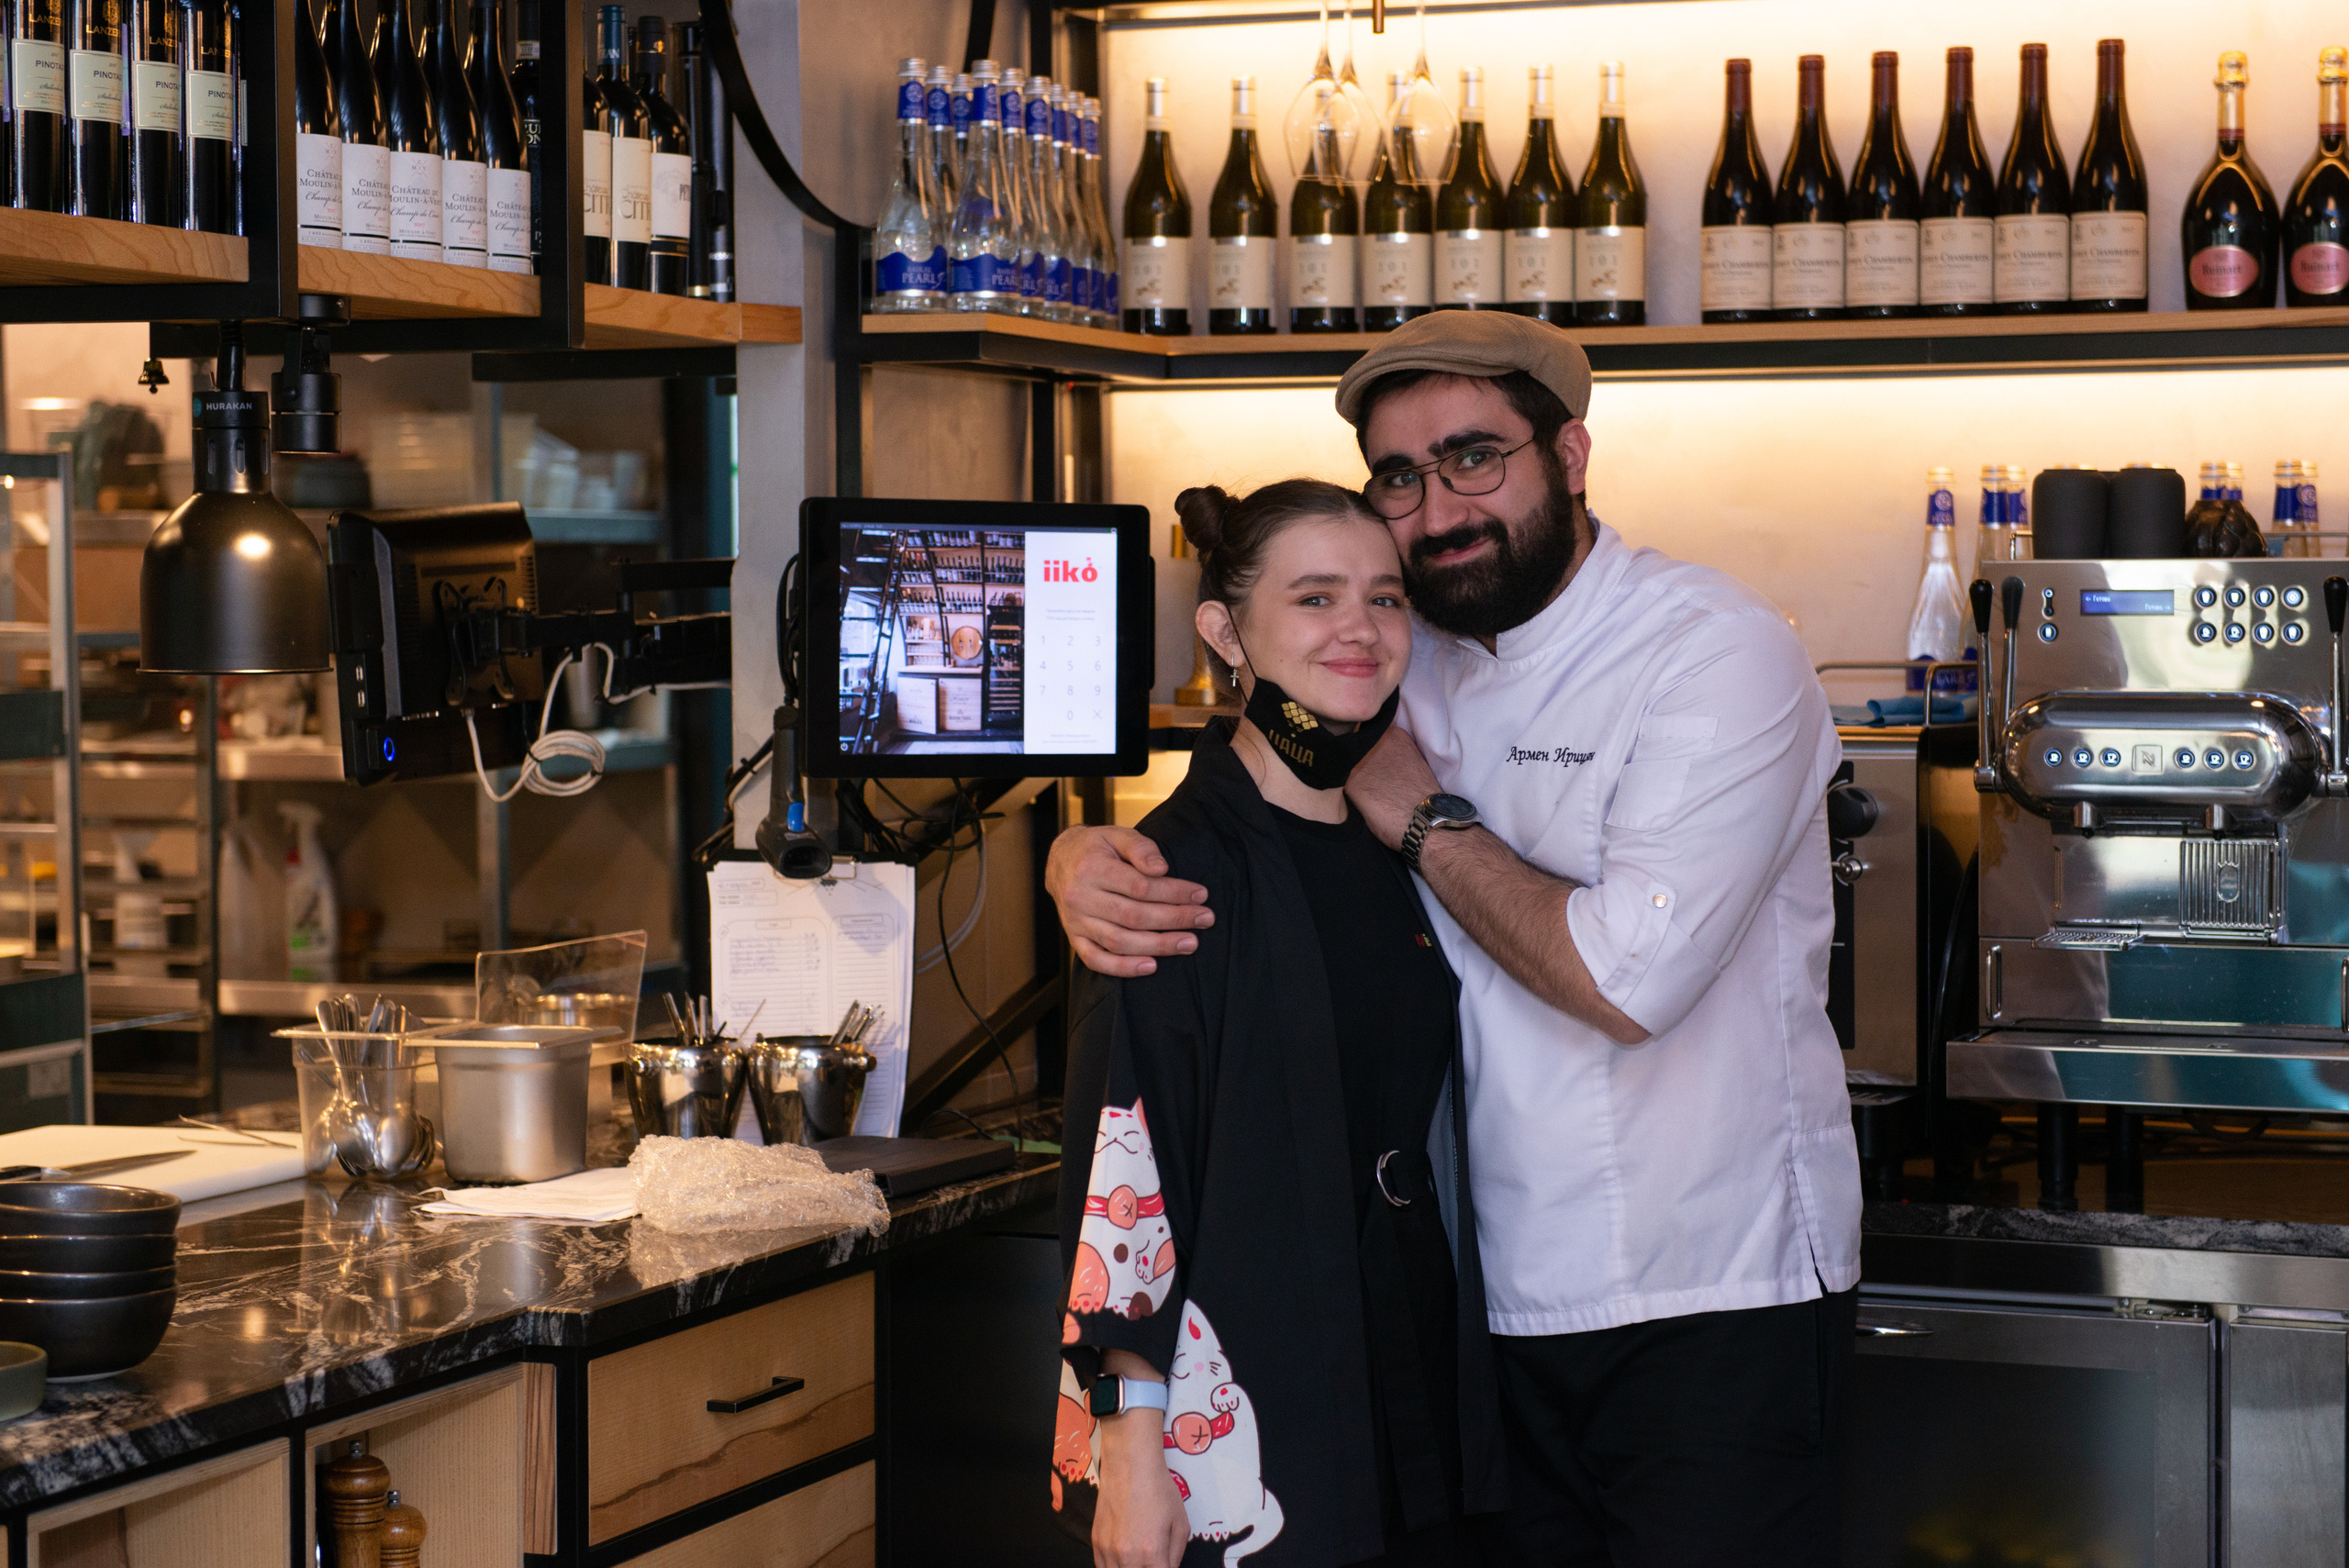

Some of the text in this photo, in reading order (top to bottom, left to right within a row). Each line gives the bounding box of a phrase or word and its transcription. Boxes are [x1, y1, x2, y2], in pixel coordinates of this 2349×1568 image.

[2203, 264, 2242, 275] Ruinart
[2301, 261, 2339, 272] Ruinart
[902, 273, 936, 284] PEARL
[206, 403, 252, 411] HURAKAN
[1041, 635, 1101, 646] 1 2 3
[1040, 661, 1101, 671] 4 5 6
[1040, 684, 1101, 696] 7 8 9
[1066, 709, 1074, 721] 0
[1506, 746, 1550, 765] Армен
